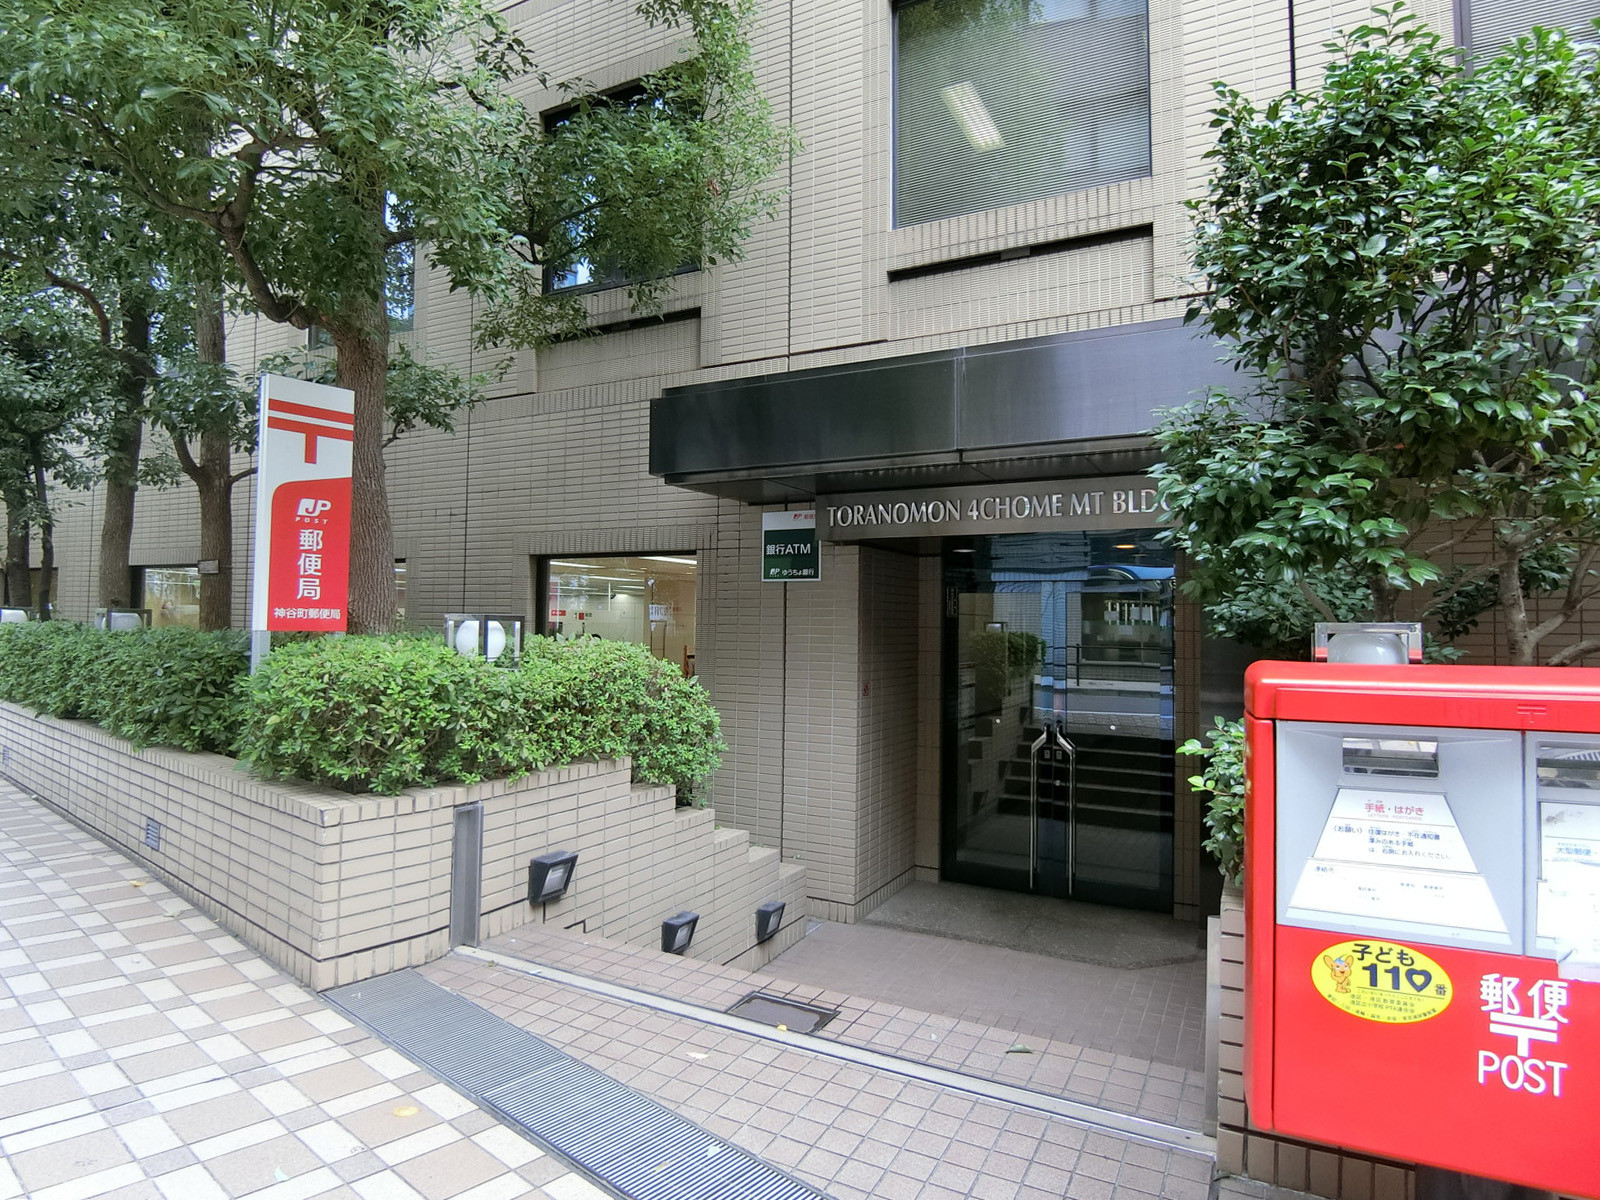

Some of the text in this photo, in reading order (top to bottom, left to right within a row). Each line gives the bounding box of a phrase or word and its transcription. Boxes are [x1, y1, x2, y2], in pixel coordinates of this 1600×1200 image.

[827, 499, 961, 528] TORANOMON
[967, 493, 1063, 520] 4CHOME
[1069, 490, 1104, 516] MT
[766, 543, 811, 555] 銀行ATM
[297, 528, 323, 600] 郵便局
[782, 568, 815, 576] ゆうちょ銀行
[273, 607, 341, 620] 神谷町郵便局
[1365, 803, 1424, 816] 手紙・はがき
[1352, 943, 1415, 967] 子ども
[1480, 973, 1568, 1024] 郵便
[1478, 1050, 1568, 1097] POST
